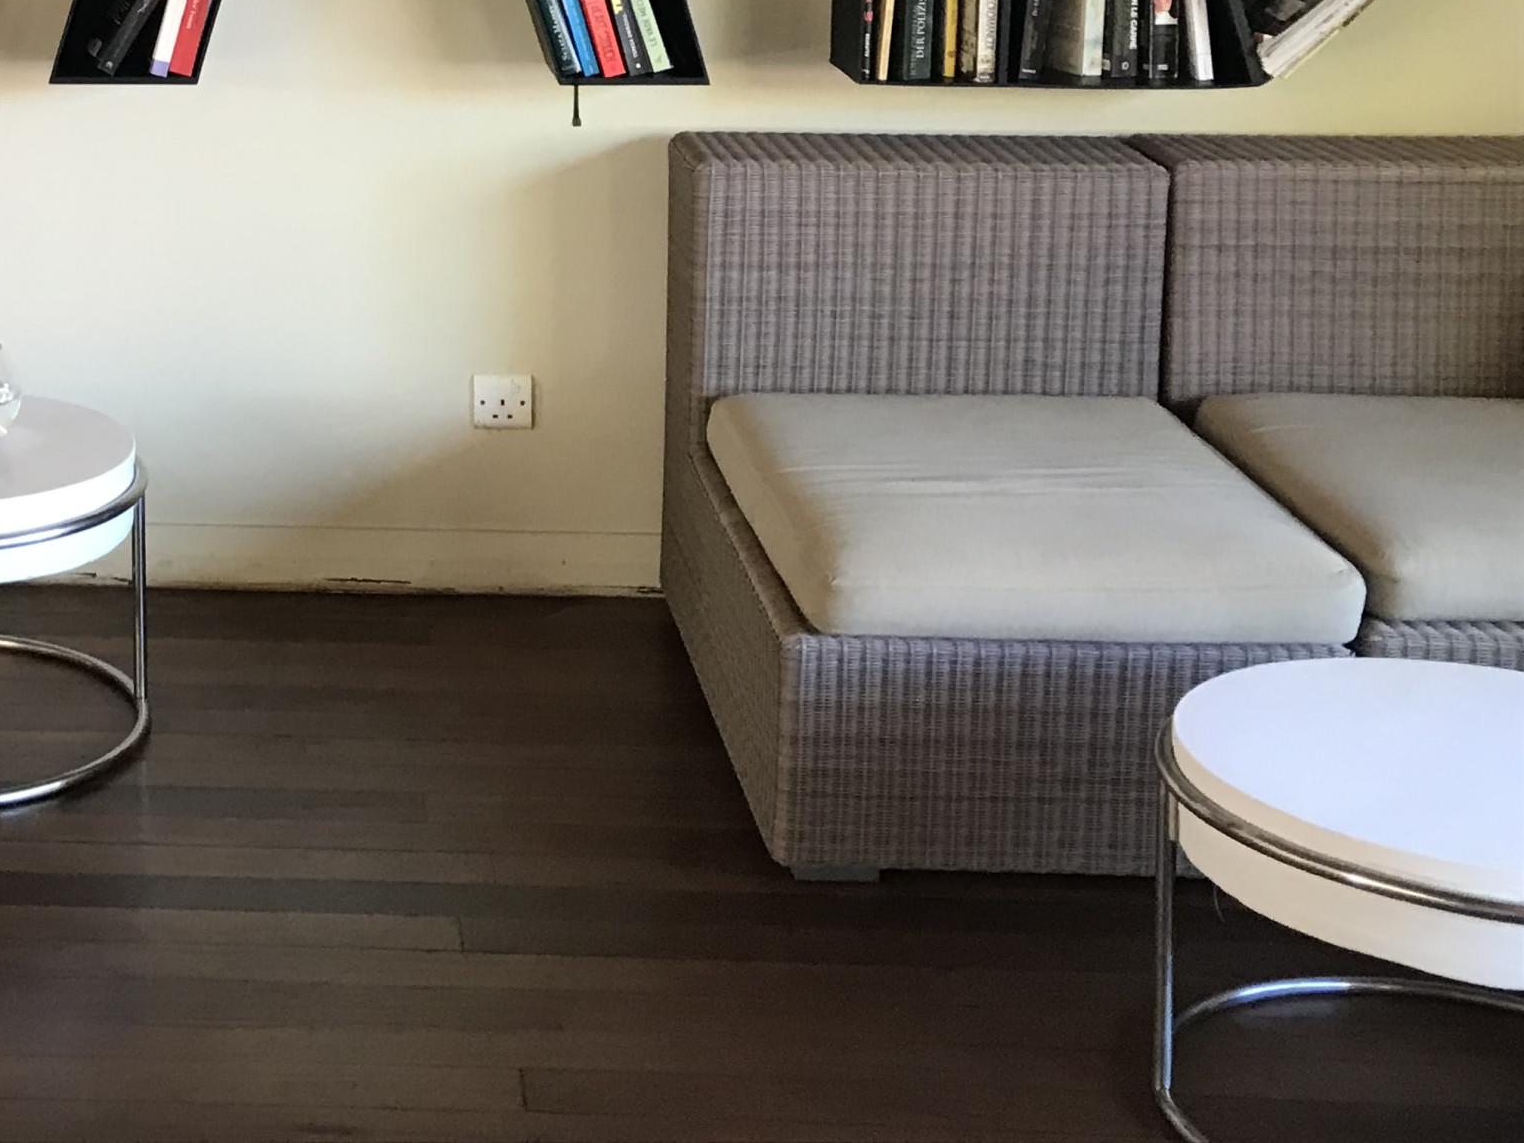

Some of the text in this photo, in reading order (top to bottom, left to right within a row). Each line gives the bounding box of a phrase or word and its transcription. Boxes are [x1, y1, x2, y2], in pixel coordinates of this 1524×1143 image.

[1129, 6, 1138, 18] LE
[641, 16, 655, 37] VADE
[647, 35, 658, 47] LE
[914, 36, 926, 58] DER
